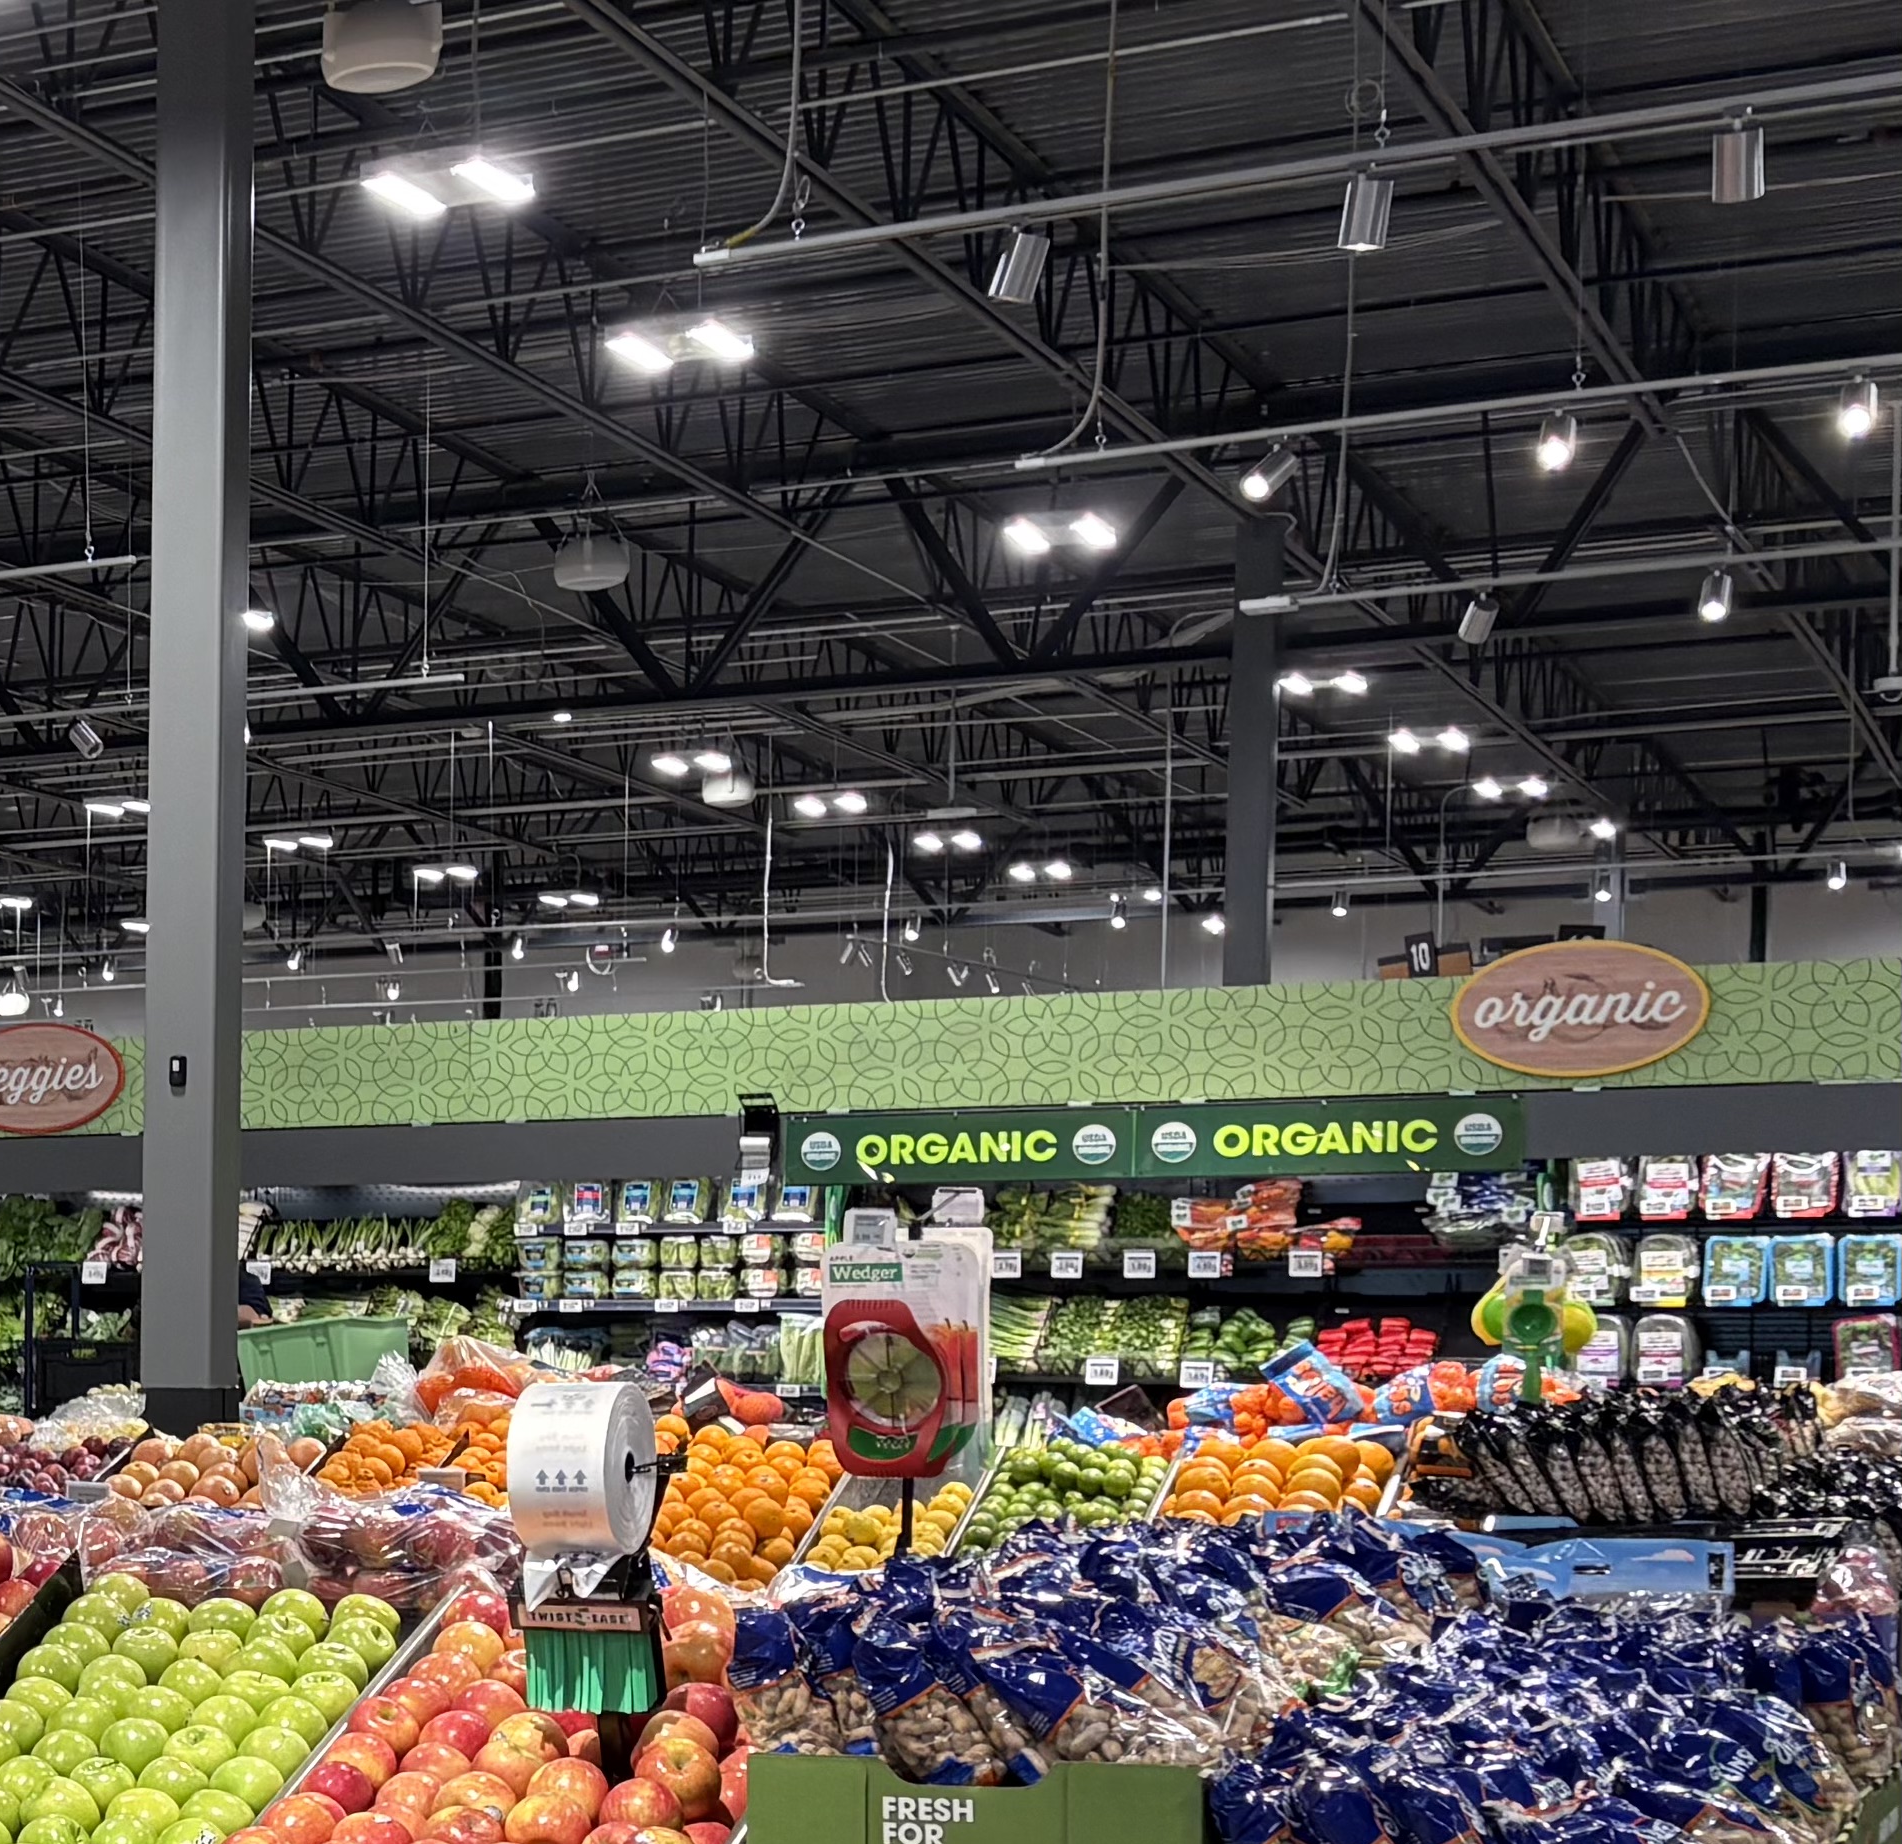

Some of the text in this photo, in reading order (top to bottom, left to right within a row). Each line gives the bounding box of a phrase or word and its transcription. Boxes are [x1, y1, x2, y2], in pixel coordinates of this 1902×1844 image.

[1409, 942, 1432, 973] 10
[1474, 981, 1688, 1042] organic
[856, 1129, 1058, 1166] ORGANIC
[1212, 1119, 1438, 1157] ORGANIC
[832, 1265, 898, 1283] Wedger
[881, 1796, 976, 1824] FRESH
